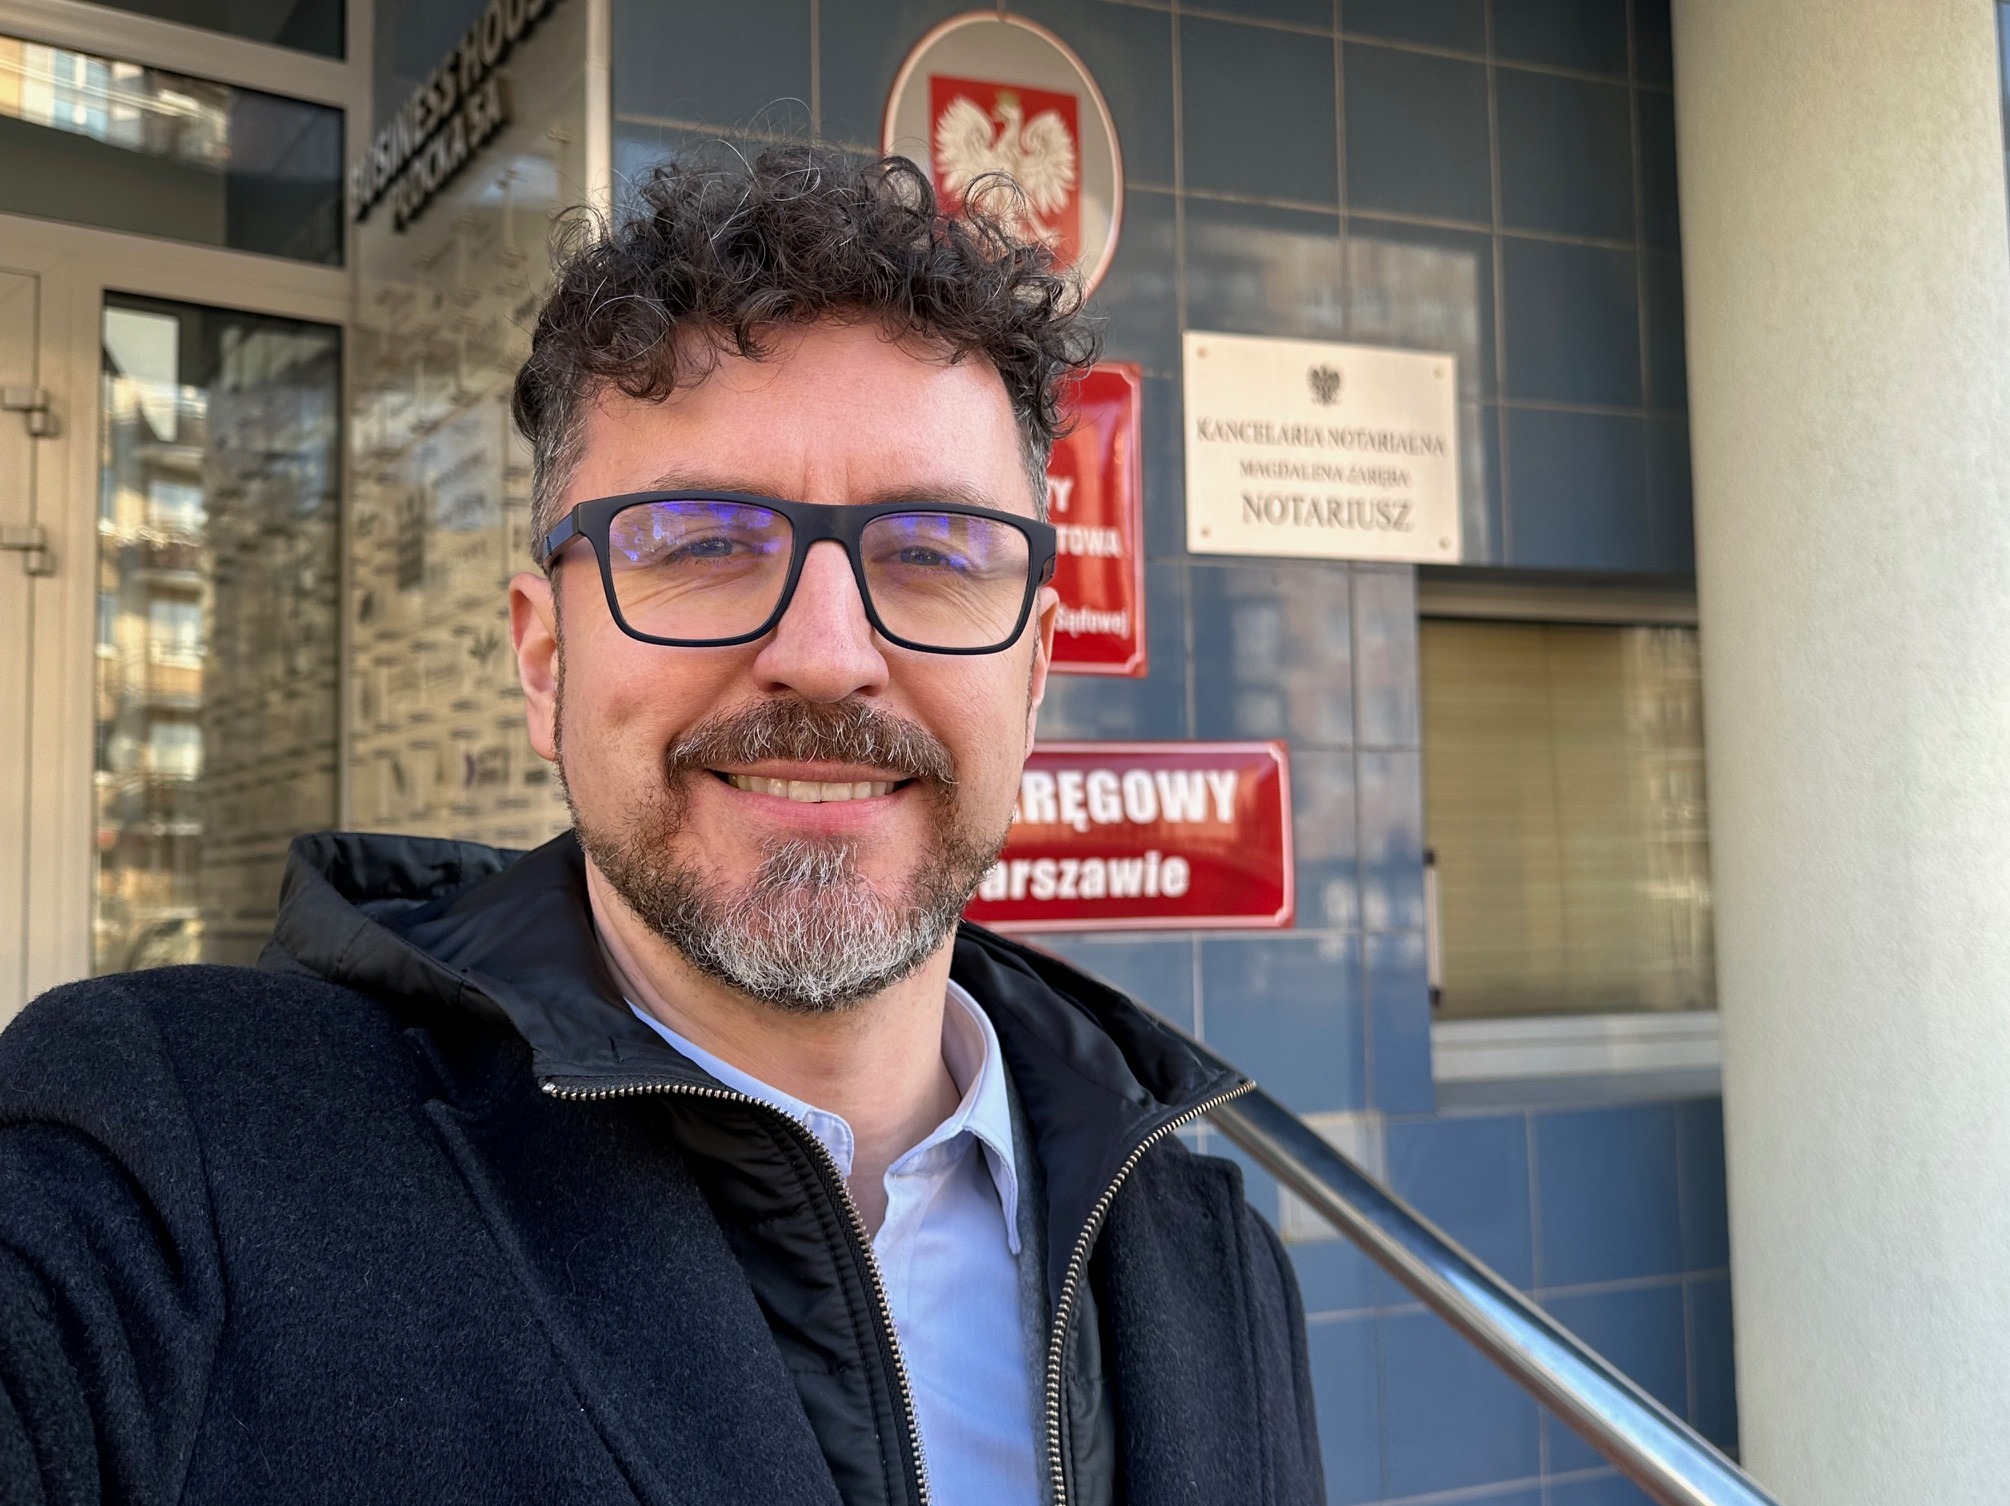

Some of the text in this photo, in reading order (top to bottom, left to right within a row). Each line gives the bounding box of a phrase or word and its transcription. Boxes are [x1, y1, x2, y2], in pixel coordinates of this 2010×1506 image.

[459, 0, 544, 92] HOU
[1196, 416, 1448, 457] KANCELARIA NOTARIALNA
[1239, 459, 1343, 484] MAGDALENA
[1242, 491, 1415, 532] NOTARIUSZ
[1056, 524, 1122, 558] TOWA
[1012, 769, 1238, 832] RĘGOWY
[978, 850, 1190, 900] arszawie
